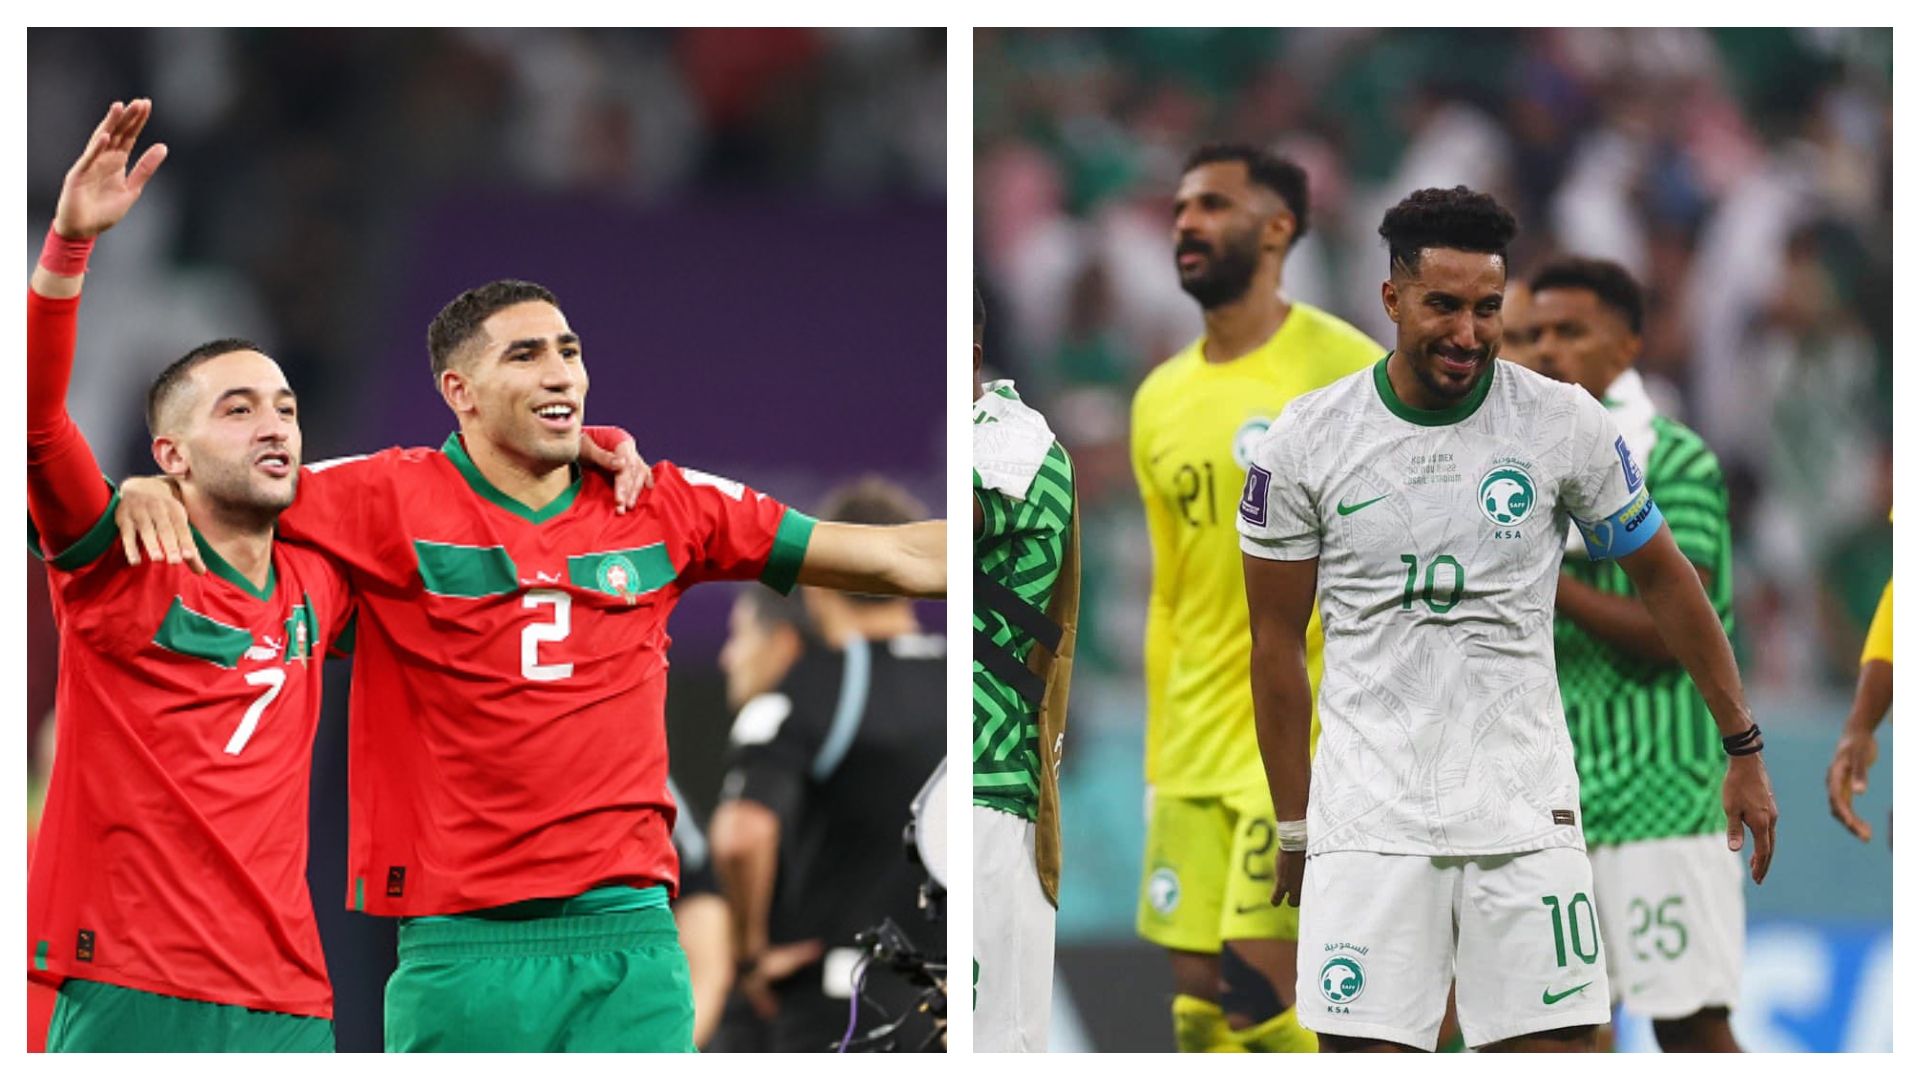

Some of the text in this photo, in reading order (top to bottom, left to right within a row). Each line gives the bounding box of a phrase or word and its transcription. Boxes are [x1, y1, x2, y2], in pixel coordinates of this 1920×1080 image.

[1495, 530, 1521, 539] KSA
[1625, 497, 1653, 532] CHILD
[1400, 554, 1464, 613] 10
[521, 589, 574, 682] 2
[223, 667, 287, 756] 7
[1324, 943, 1369, 956] السعودية
[1541, 892, 1598, 967] 10
[1628, 896, 1688, 961] 25
[1327, 1006, 1350, 1014] KSA
